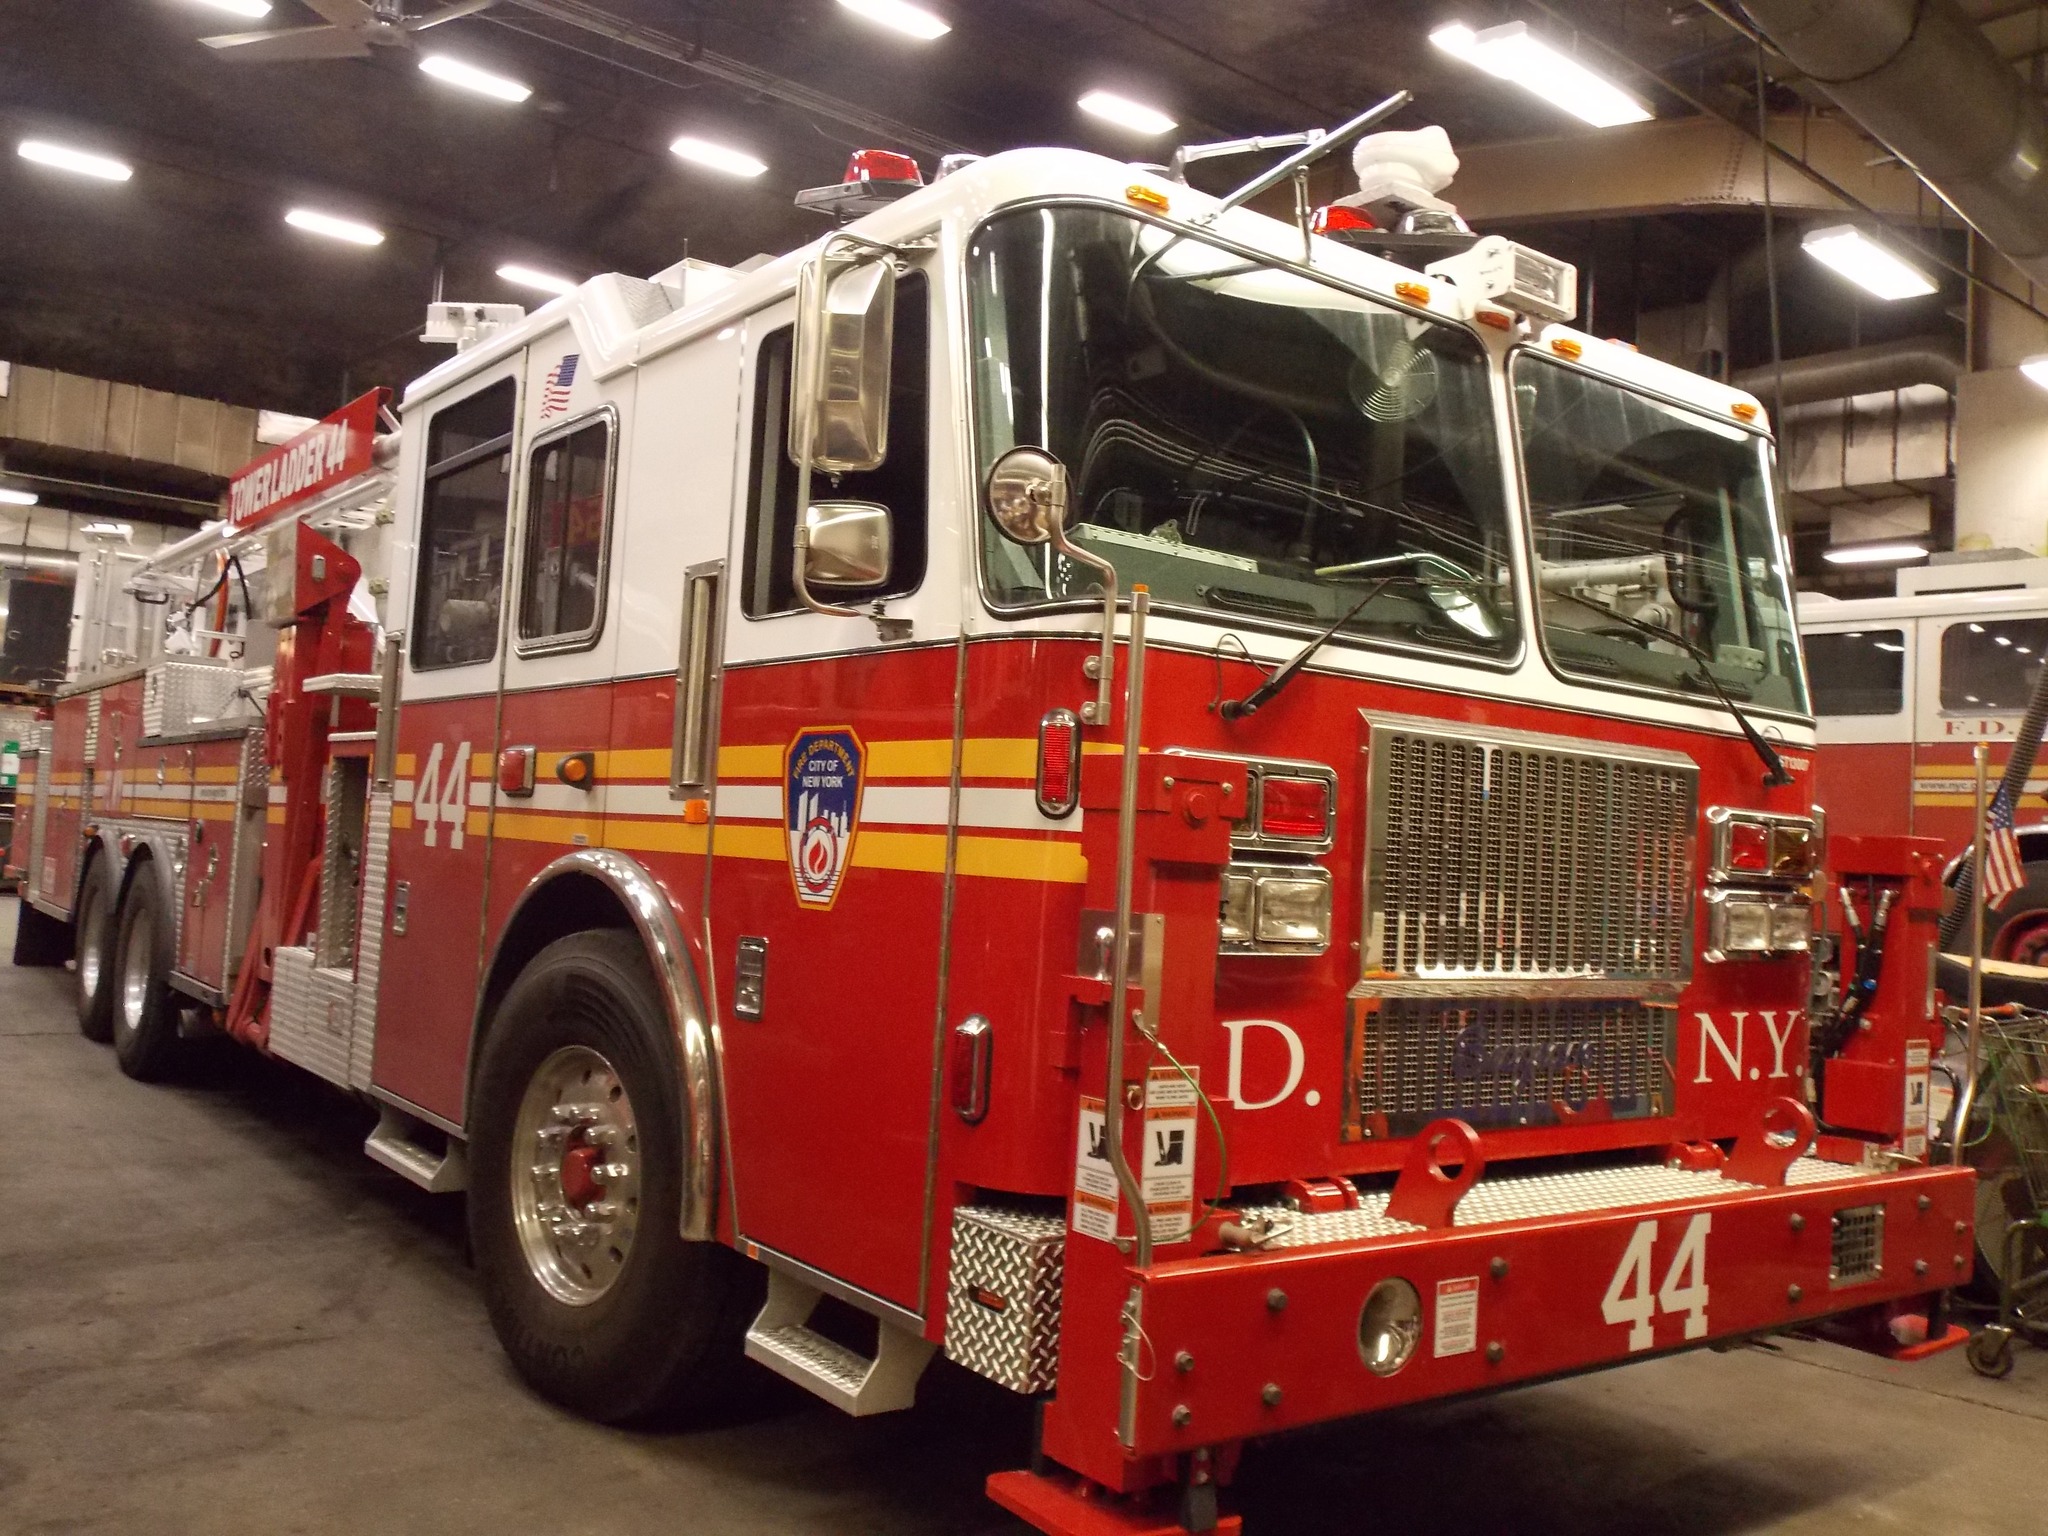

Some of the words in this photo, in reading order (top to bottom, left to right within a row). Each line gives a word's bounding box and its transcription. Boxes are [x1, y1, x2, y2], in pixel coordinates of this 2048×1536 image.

[230, 462, 271, 525] TOWER
[269, 433, 326, 504] LADDER
[326, 419, 348, 475] 44
[808, 738, 855, 777] DEPARTMENT
[1945, 720, 2014, 736] F.D.
[415, 741, 471, 850] 44
[802, 776, 821, 788] NEW
[821, 776, 844, 788] YORK
[808, 760, 826, 772] CITY
[827, 759, 839, 772] OF
[1221, 1019, 1321, 1110] D.
[1693, 1010, 1804, 1083] N.Y.
[1601, 1212, 1712, 1352] 44
